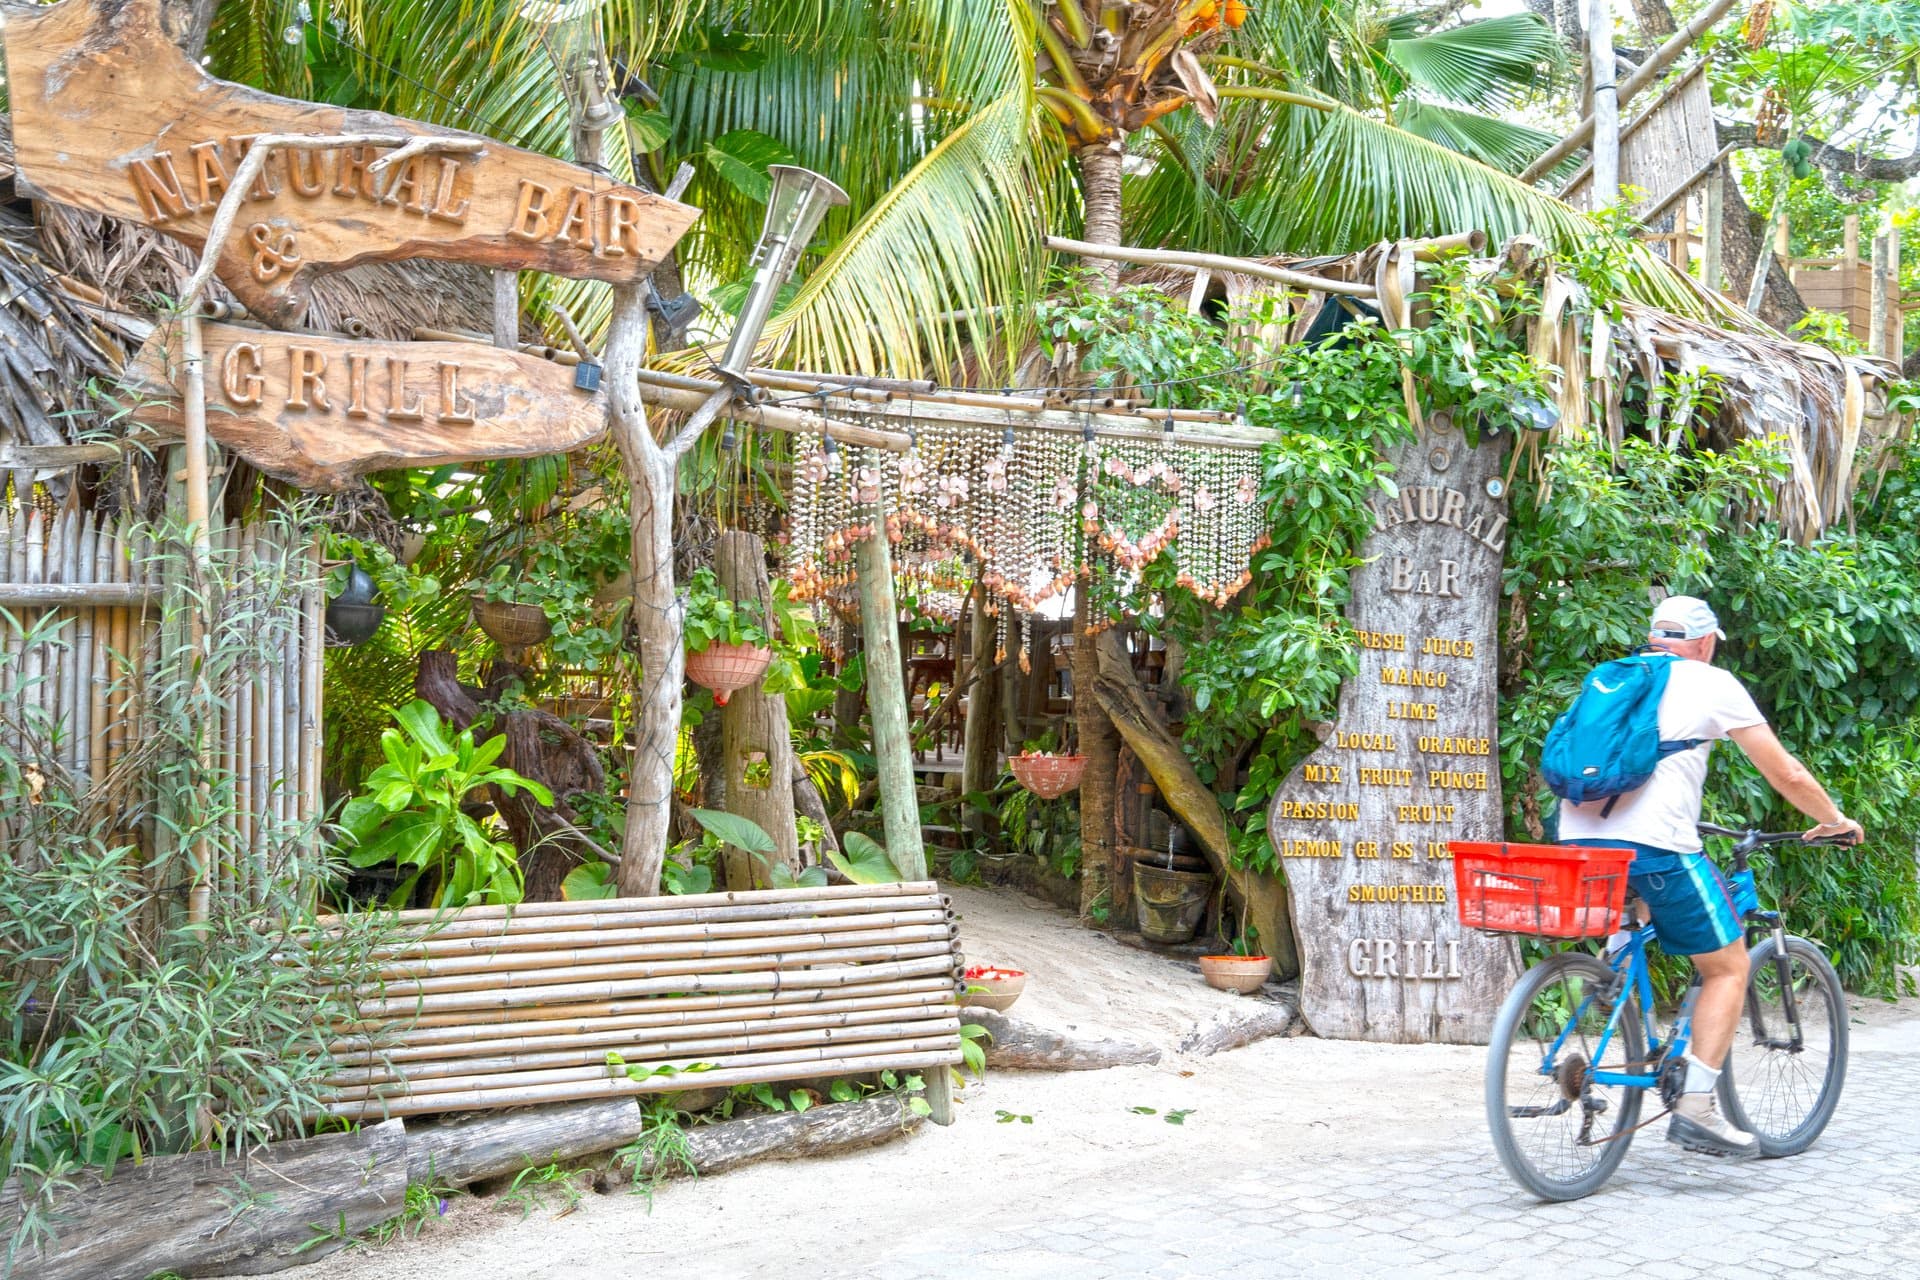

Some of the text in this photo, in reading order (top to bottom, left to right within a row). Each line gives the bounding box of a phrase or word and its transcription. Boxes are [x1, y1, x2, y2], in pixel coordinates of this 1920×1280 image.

[506, 178, 643, 258] BAR
[249, 222, 300, 284] &
[222, 341, 477, 426] GRILL
[1390, 556, 1462, 599] BAR
[1351, 629, 1475, 659] RESH JUICE
[1381, 667, 1447, 689] MANGO
[1388, 702, 1438, 721] LIME
[1337, 731, 1490, 756] LOCAL ORANGE
[1304, 764, 1487, 790] MIX FRUIT PUNCH
[1281, 800, 1456, 823] PASSION FRUIT
[1281, 839, 1342, 858] LEMON
[1349, 885, 1447, 905] SMOOTHIE
